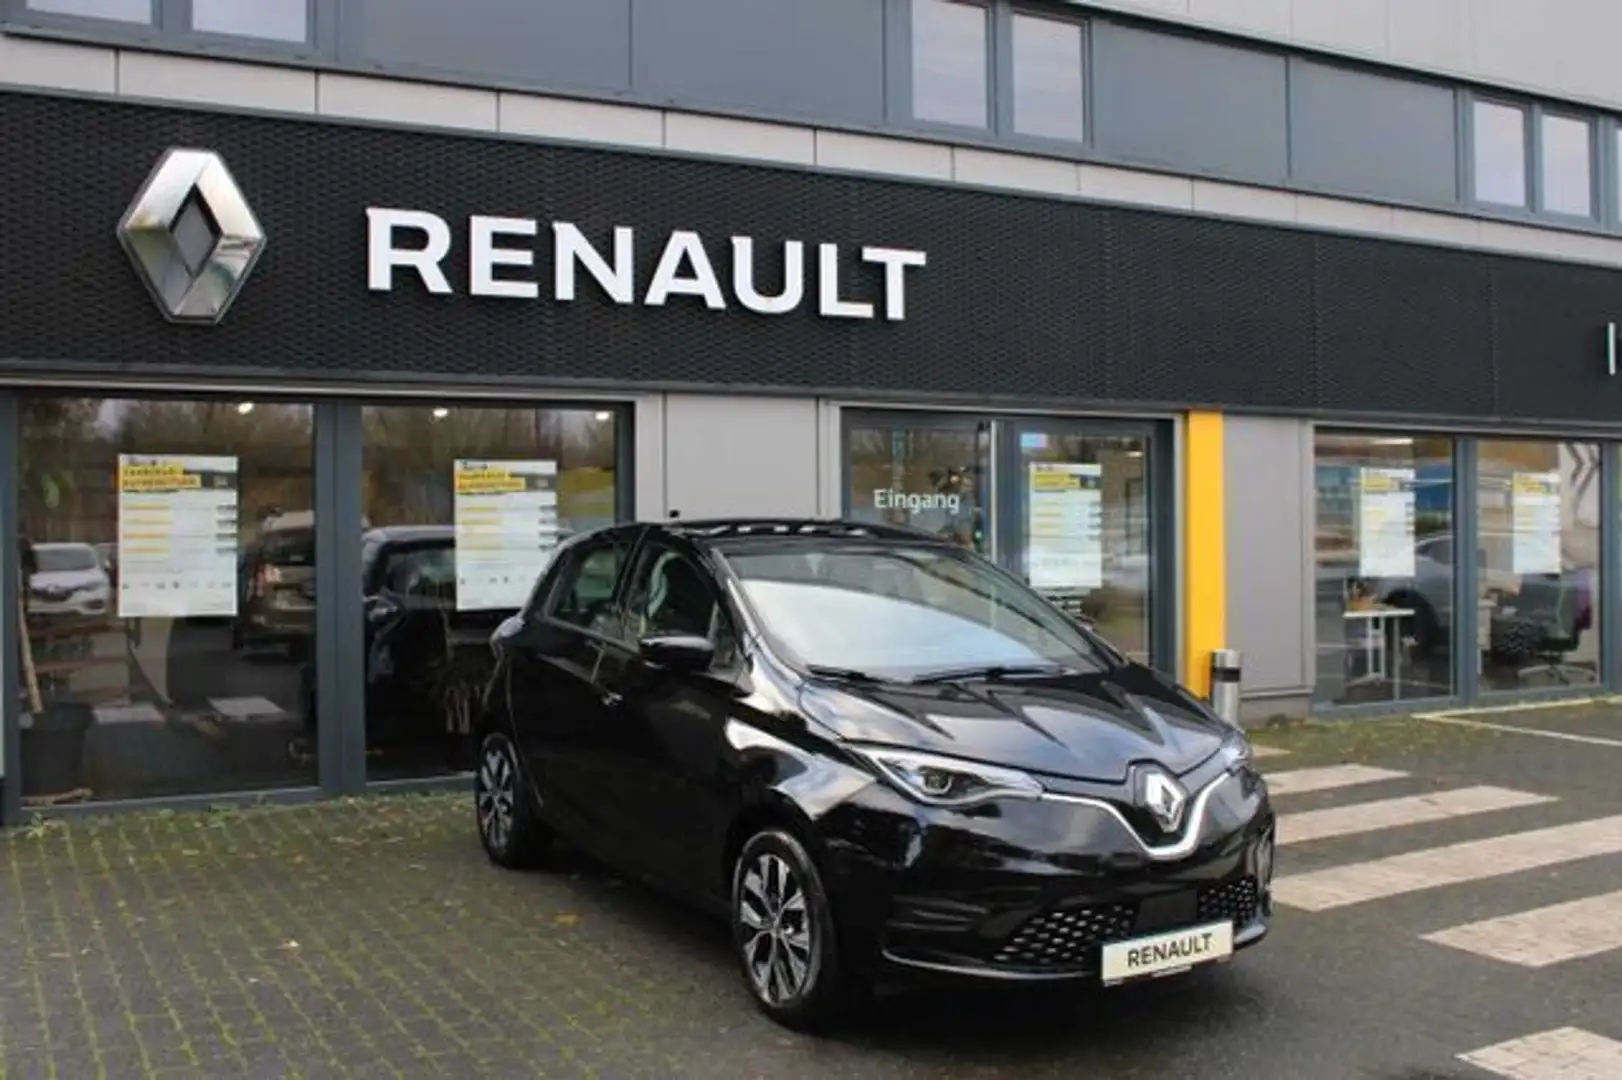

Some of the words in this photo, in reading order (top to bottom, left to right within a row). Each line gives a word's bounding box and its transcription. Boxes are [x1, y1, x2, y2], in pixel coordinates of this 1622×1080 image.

[366, 207, 926, 321] RENAULT
[873, 487, 960, 515] Eingang
[1127, 933, 1212, 967] RENAULT
